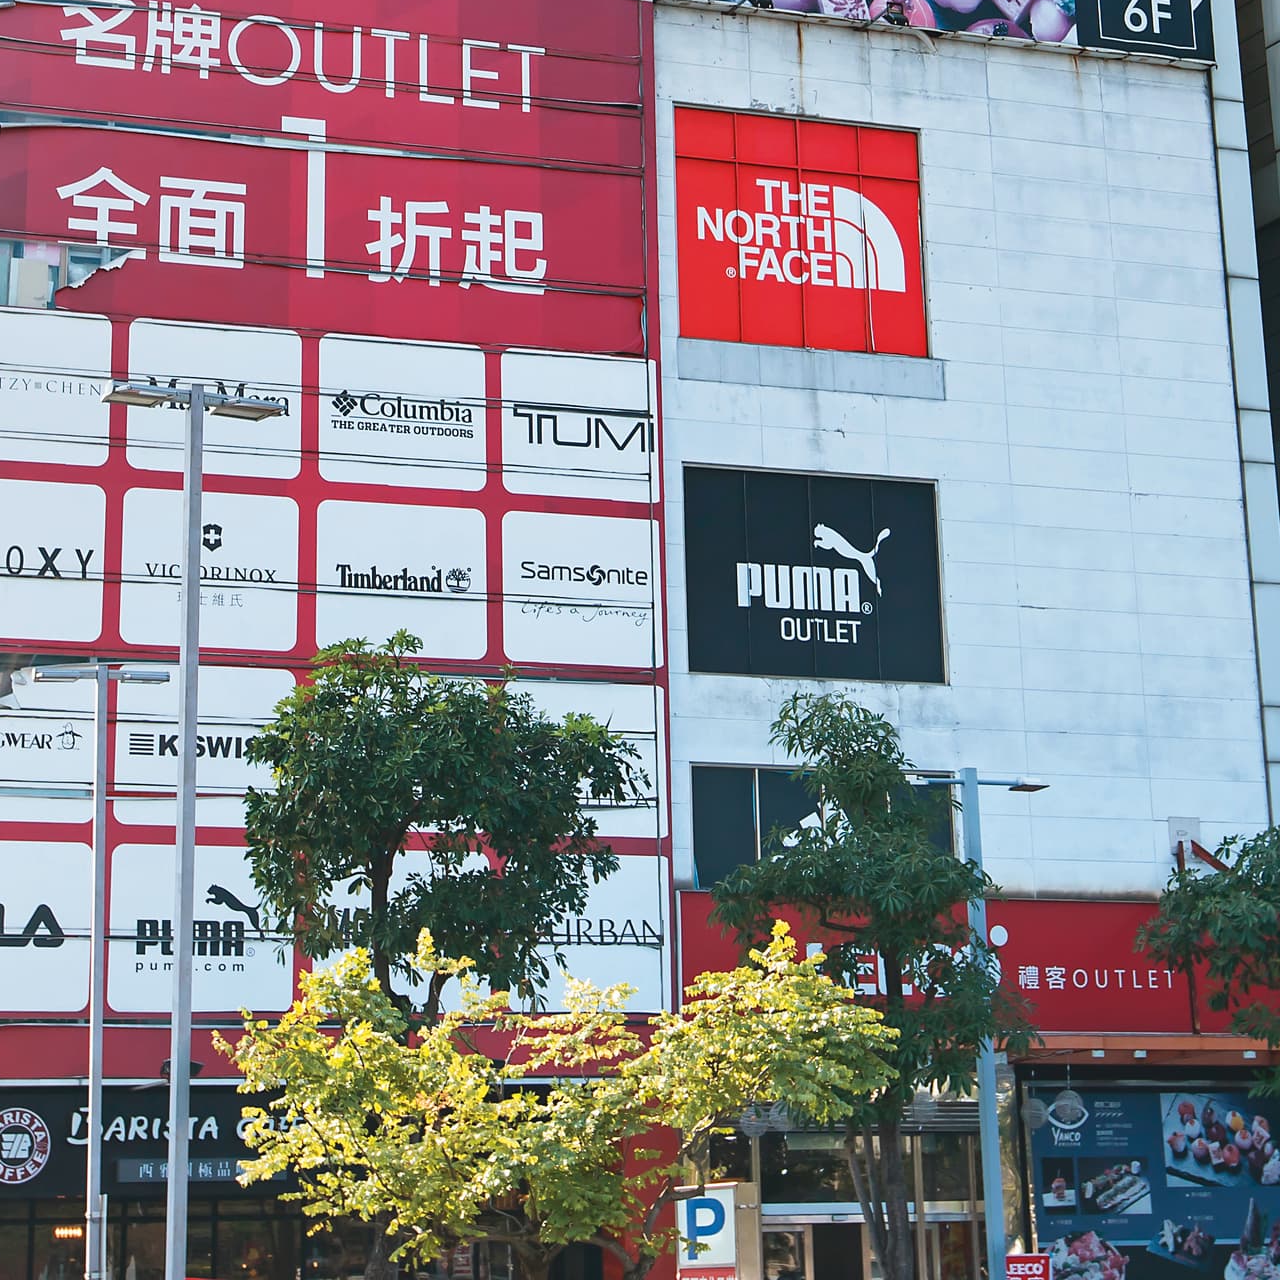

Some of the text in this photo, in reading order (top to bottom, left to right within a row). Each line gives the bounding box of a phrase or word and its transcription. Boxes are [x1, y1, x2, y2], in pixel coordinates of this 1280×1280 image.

[755, 177, 831, 218] THE
[696, 206, 834, 253] NORTH
[738, 245, 835, 288] FACE
[45, 379, 102, 396] CHEN
[359, 392, 473, 424] Columbia
[331, 419, 474, 439] THE GREATER OUTDOORS
[144, 562, 278, 584] VICORINOX
[335, 563, 443, 593] Timberland
[520, 560, 648, 586] Samsonite
[736, 560, 861, 613] PUMA
[779, 616, 862, 645] OUTLET
[135, 959, 245, 973] pum.com
[685, 1196, 726, 1261] P
